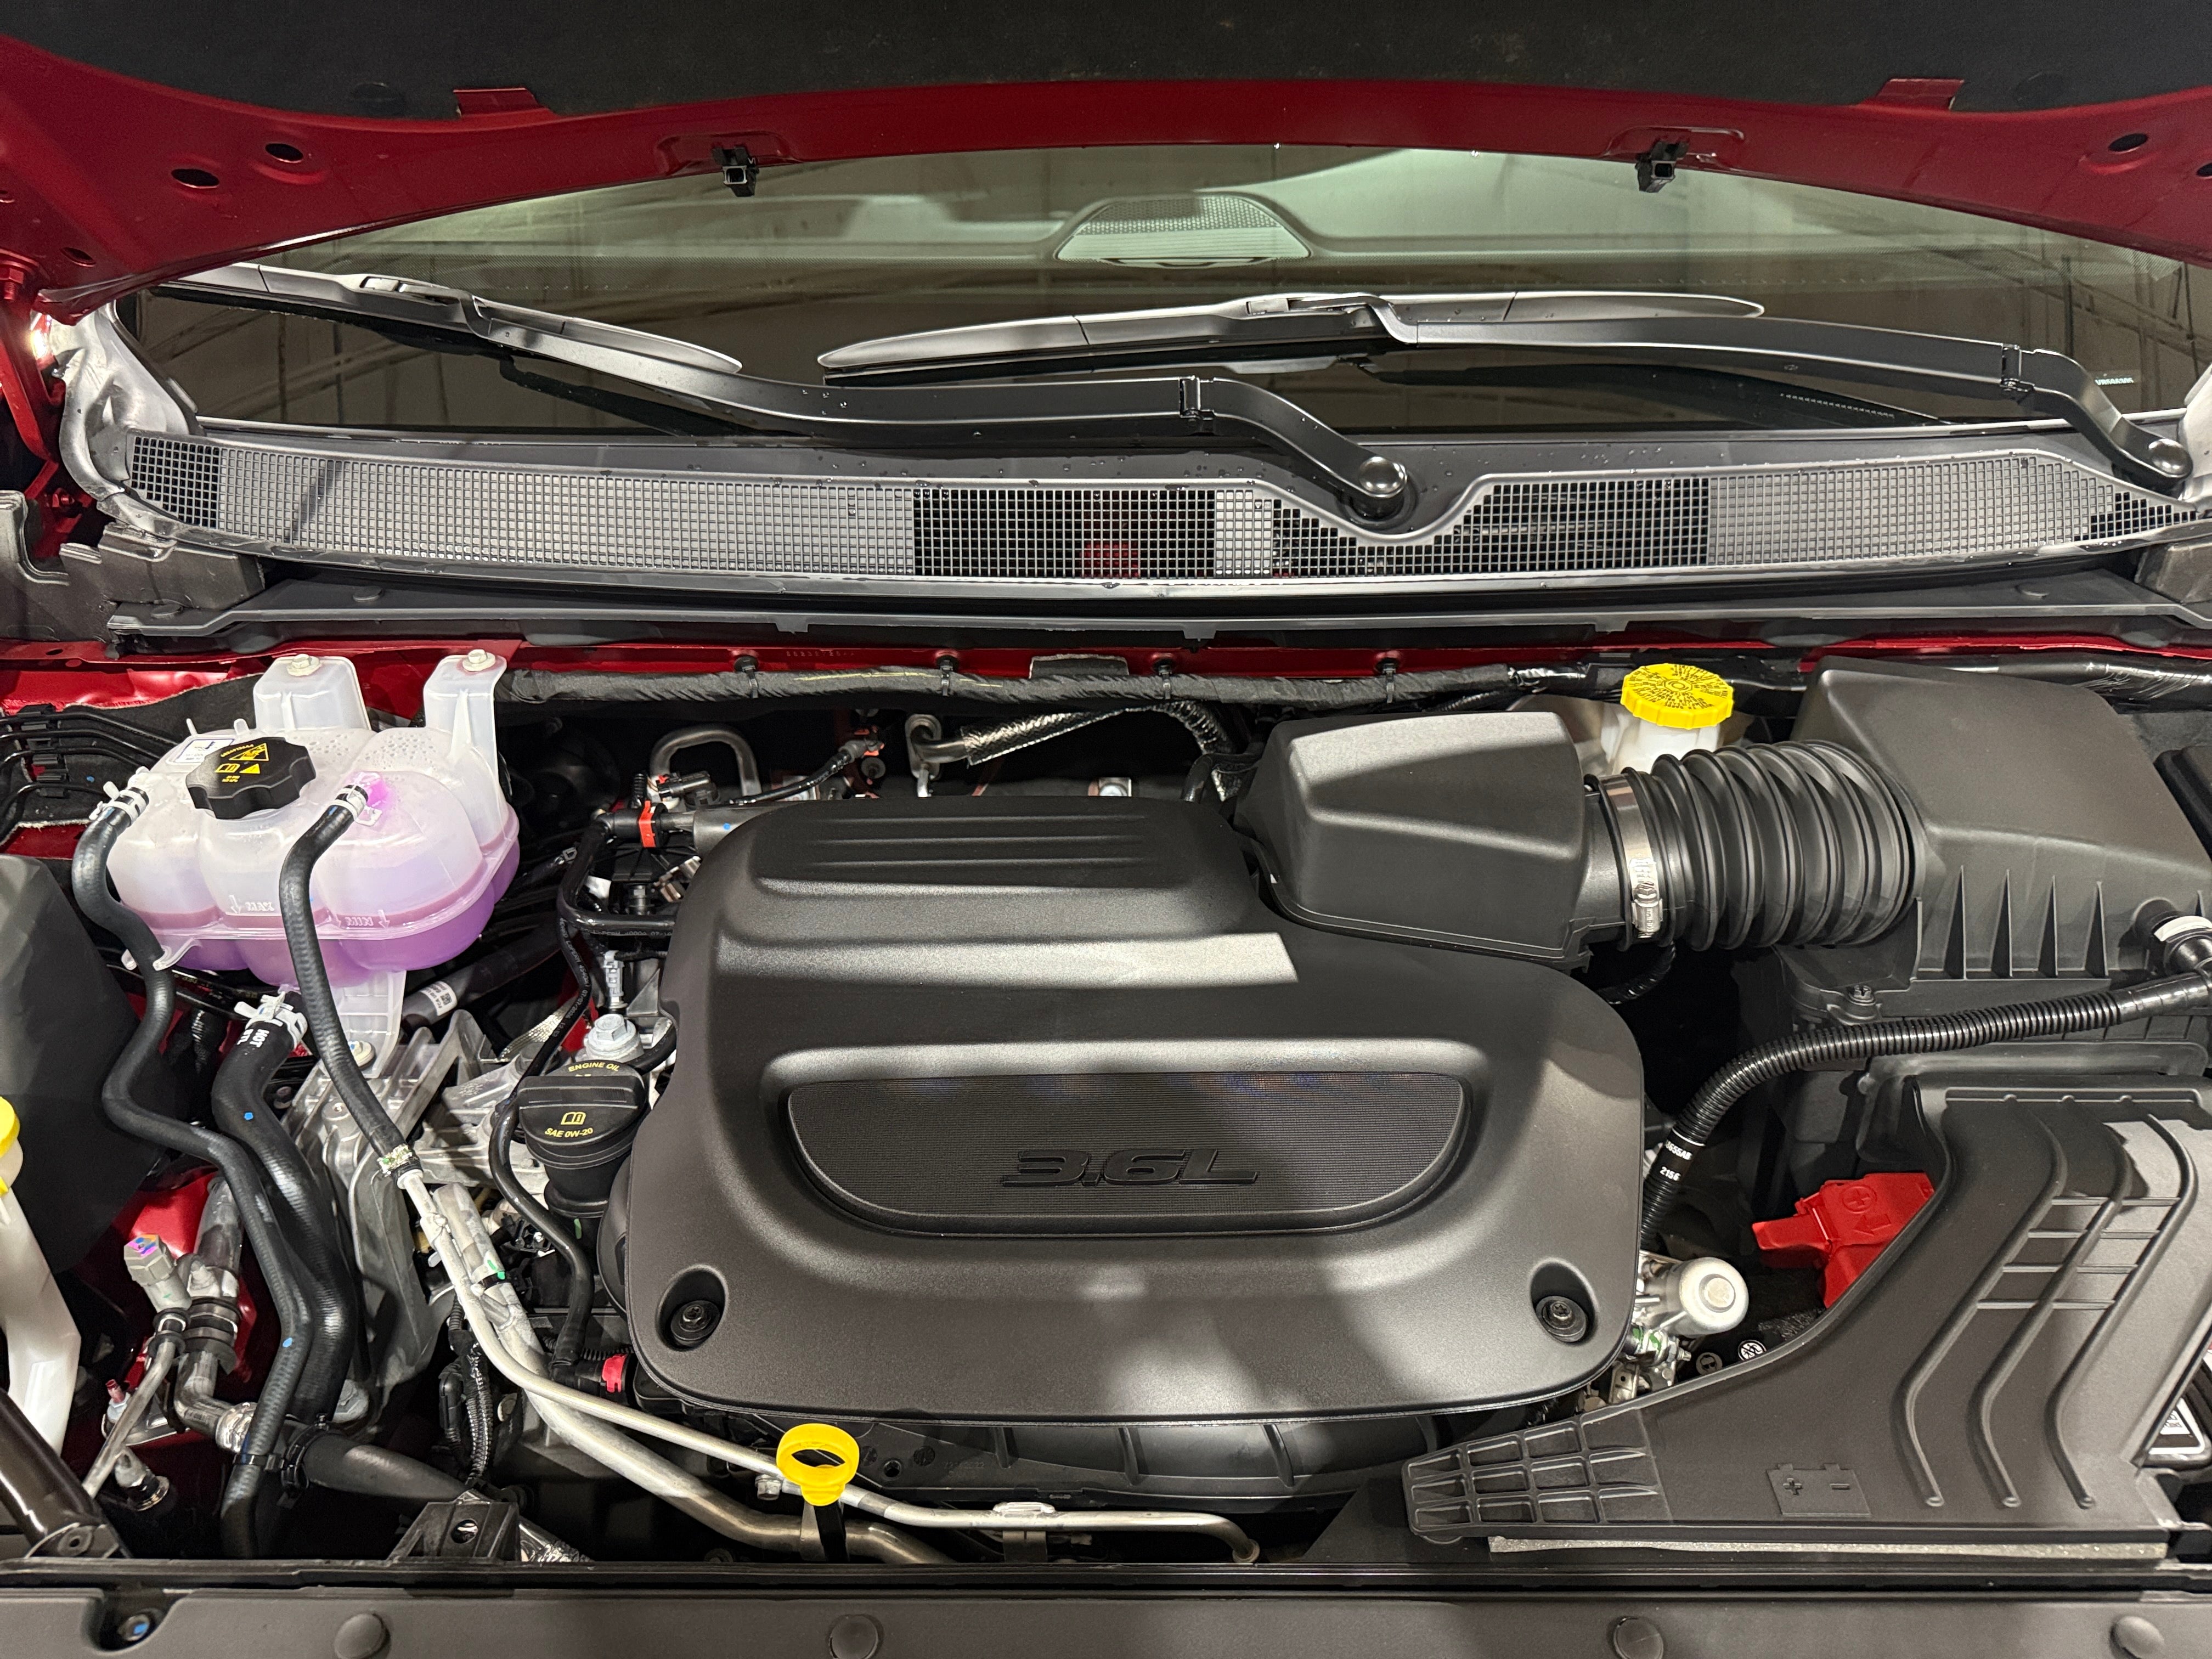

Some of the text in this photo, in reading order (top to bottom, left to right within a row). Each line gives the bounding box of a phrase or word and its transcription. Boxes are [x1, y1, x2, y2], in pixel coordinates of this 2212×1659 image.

[249, 1029, 270, 1048] HOT
[568, 1062, 620, 1072] ENGINE OIL
[544, 1127, 594, 1138] SAE 0W-20
[1002, 1148, 1259, 1187] 3.6L
